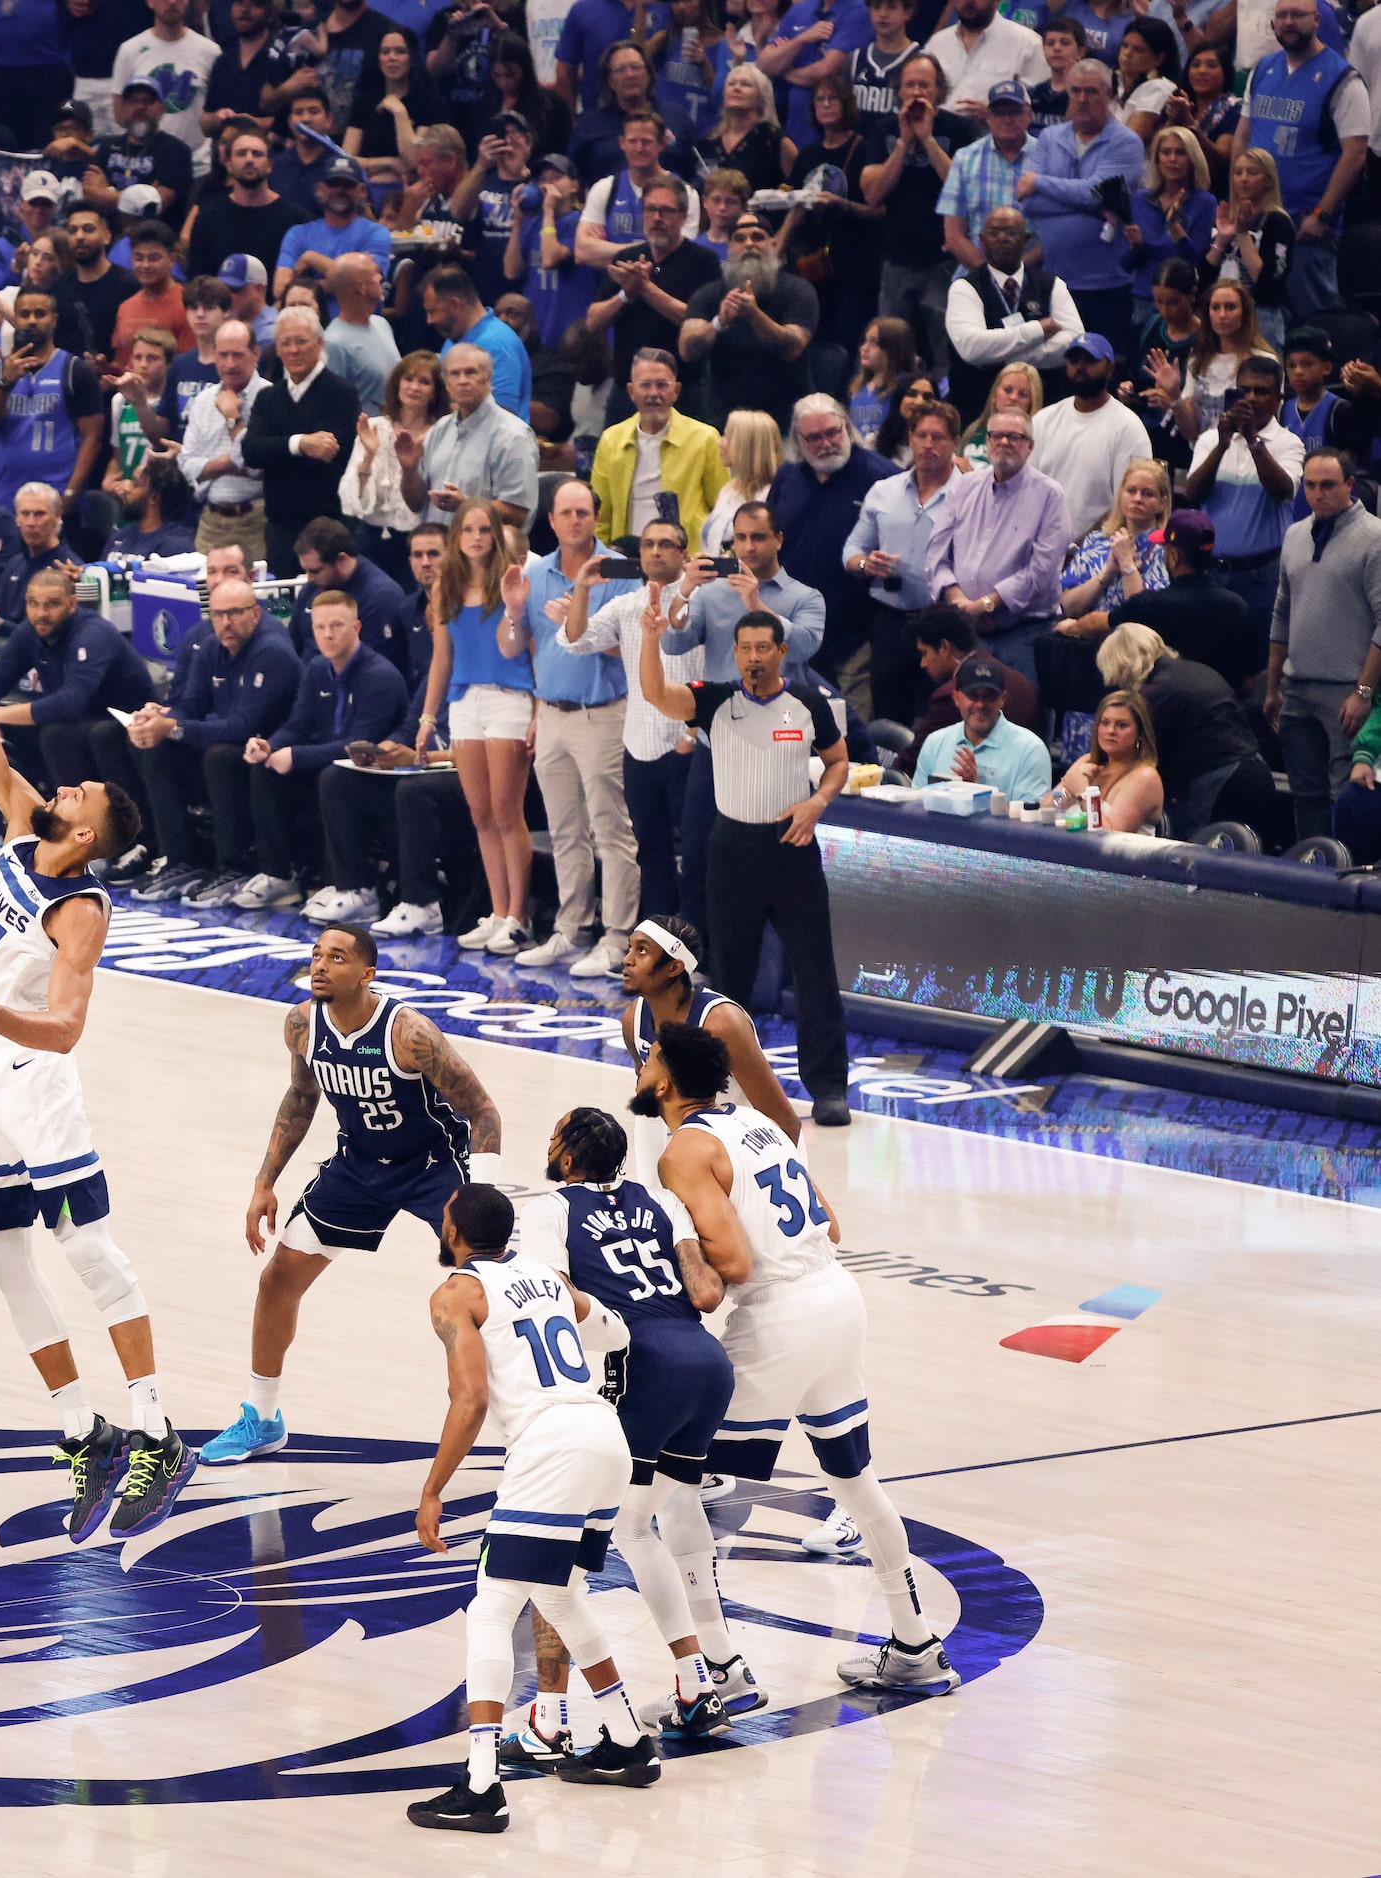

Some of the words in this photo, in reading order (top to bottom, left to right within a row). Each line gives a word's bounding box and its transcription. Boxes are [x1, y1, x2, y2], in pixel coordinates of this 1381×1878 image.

[31, 420, 55, 451] 11
[1144, 971, 1267, 1041] Google
[1275, 991, 1354, 1046] Pixel
[357, 1045, 382, 1056] chime
[312, 1058, 393, 1100] MAVS
[358, 1099, 403, 1131] 25
[741, 1127, 784, 1156] TOWNS
[753, 1157, 832, 1238] 32
[581, 1209, 628, 1242] JONES
[630, 1206, 658, 1233] JR.
[599, 1237, 684, 1302] 55
[504, 1278, 562, 1309] CONLEY
[512, 1315, 592, 1388] 10
